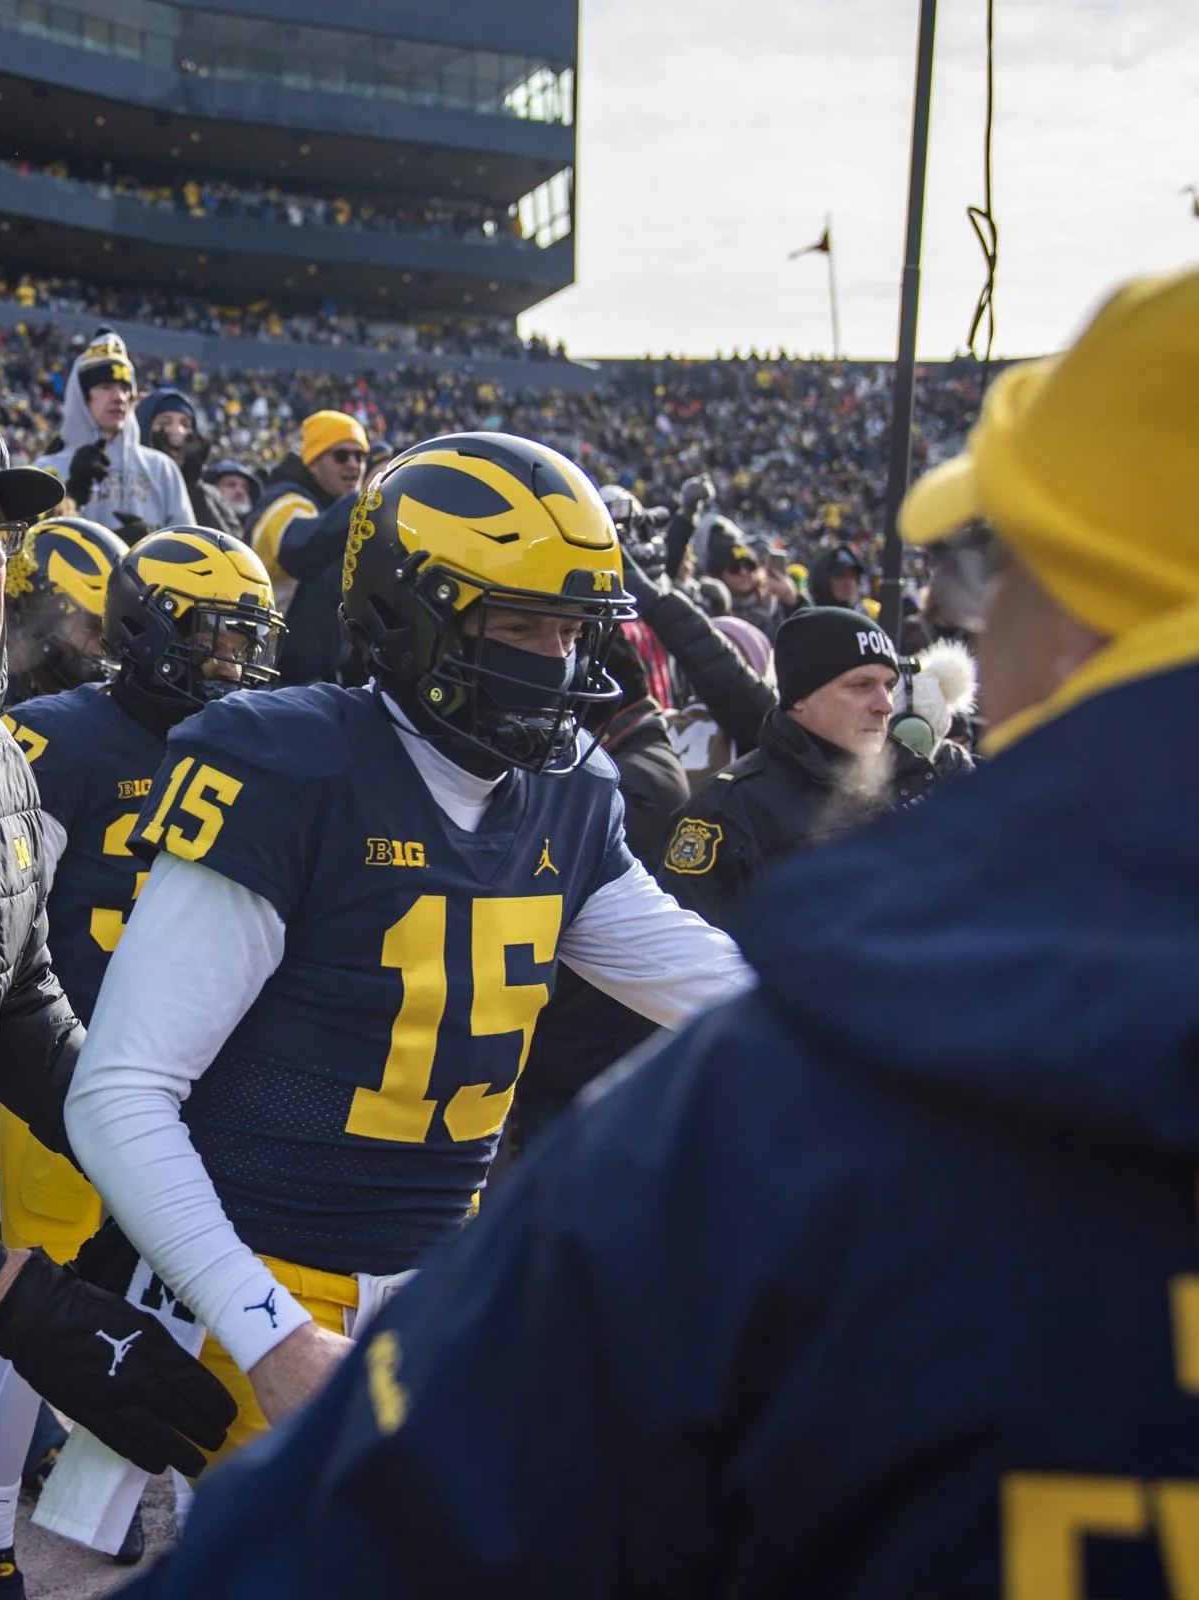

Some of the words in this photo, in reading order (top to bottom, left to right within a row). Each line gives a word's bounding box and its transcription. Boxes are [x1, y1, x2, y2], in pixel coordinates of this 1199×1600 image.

[593, 572, 613, 592] M
[141, 756, 244, 862] 15
[345, 894, 564, 1144] 15
